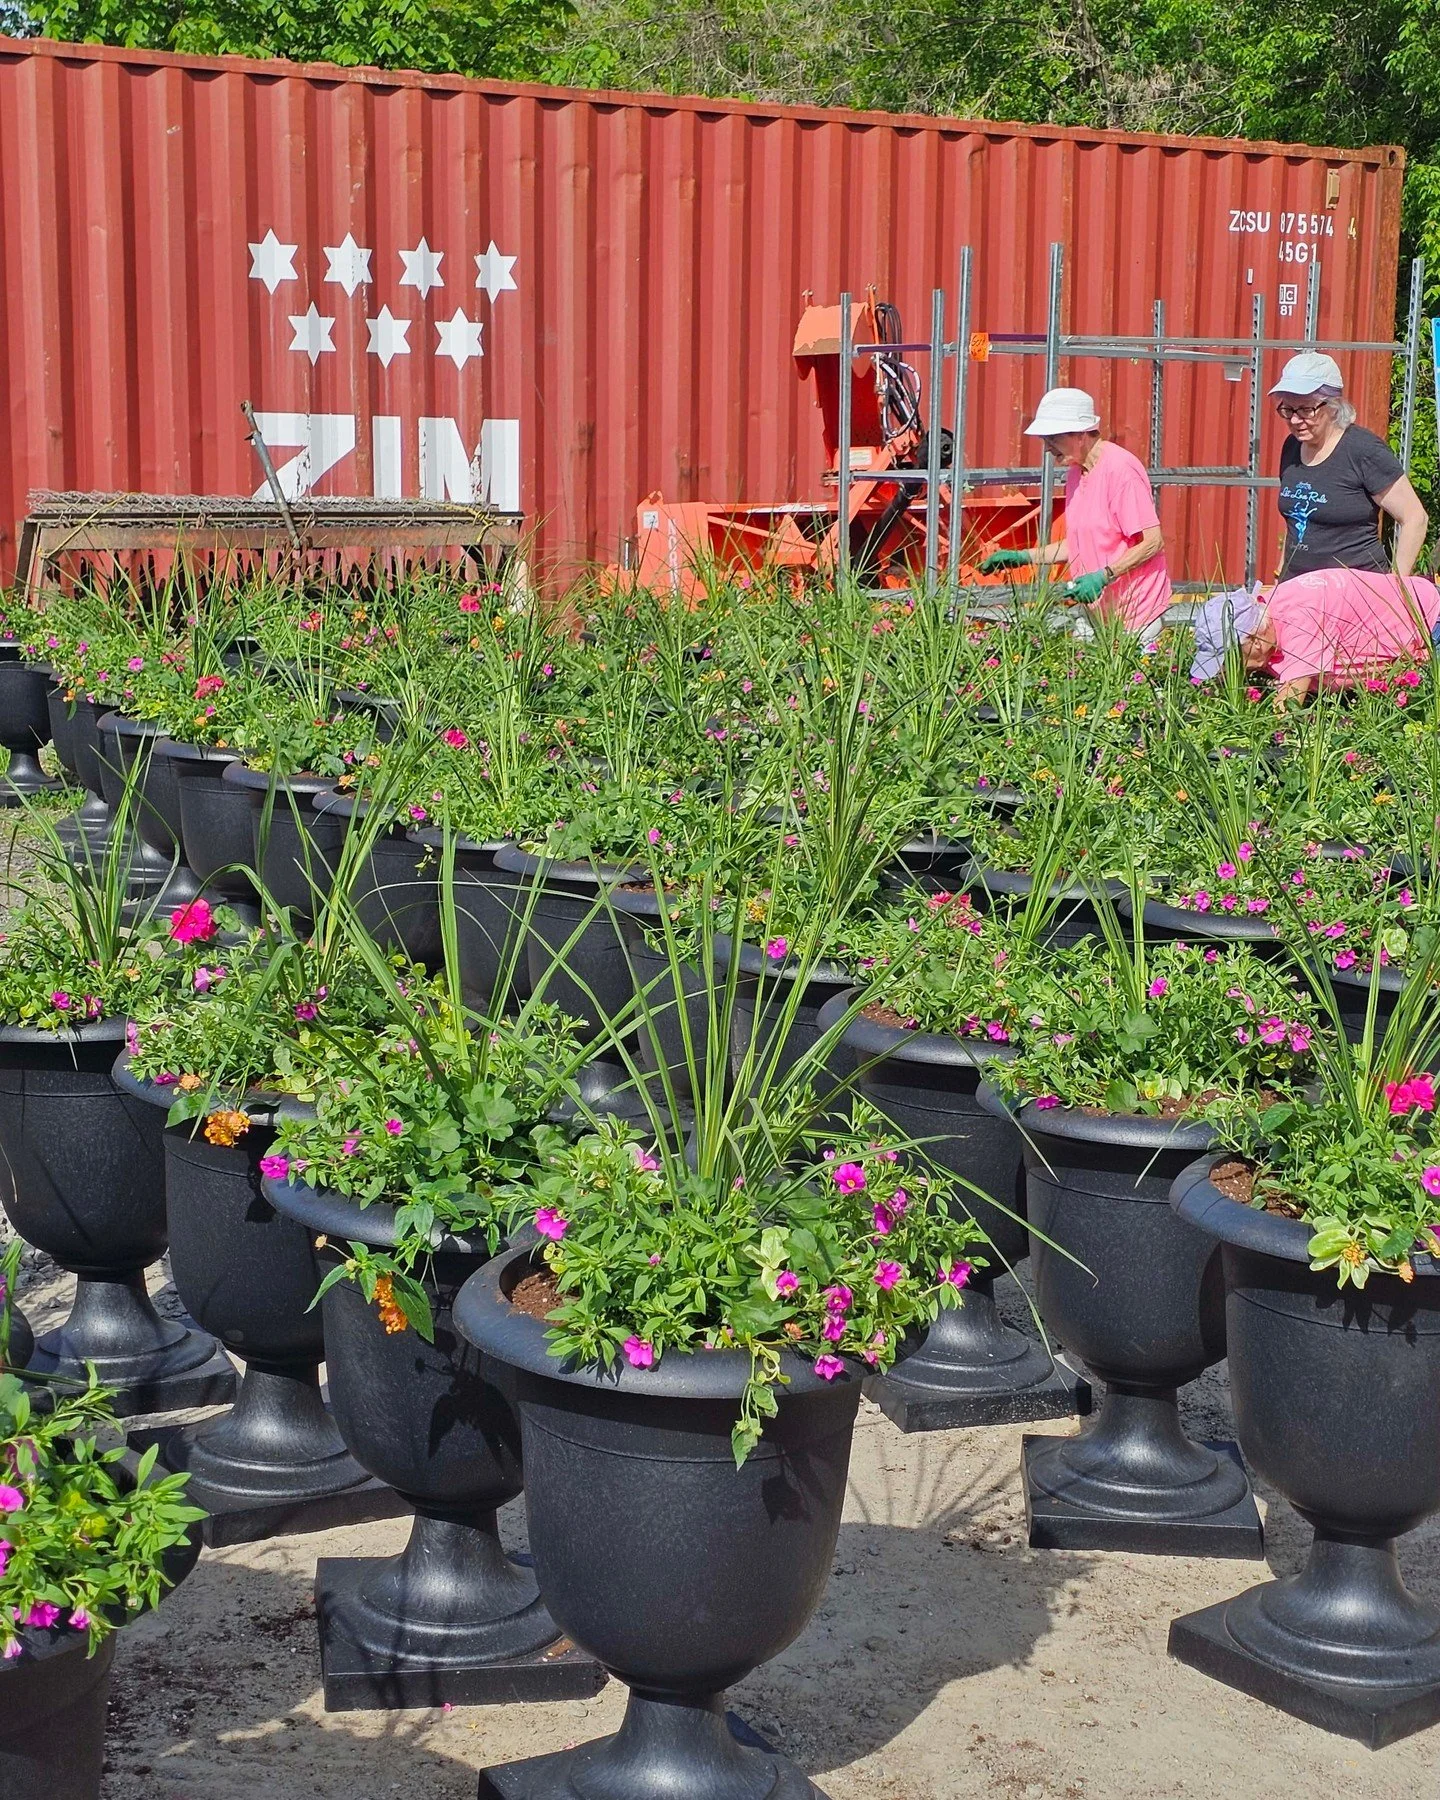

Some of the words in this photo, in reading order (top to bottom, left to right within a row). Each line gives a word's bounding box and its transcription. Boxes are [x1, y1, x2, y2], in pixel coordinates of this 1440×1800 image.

[1229, 210, 1271, 233] ZCSU
[1280, 212, 1334, 237] 875574
[1278, 240, 1318, 264] 45G1
[1280, 305, 1293, 316] 81
[251, 412, 520, 512] ZIM
